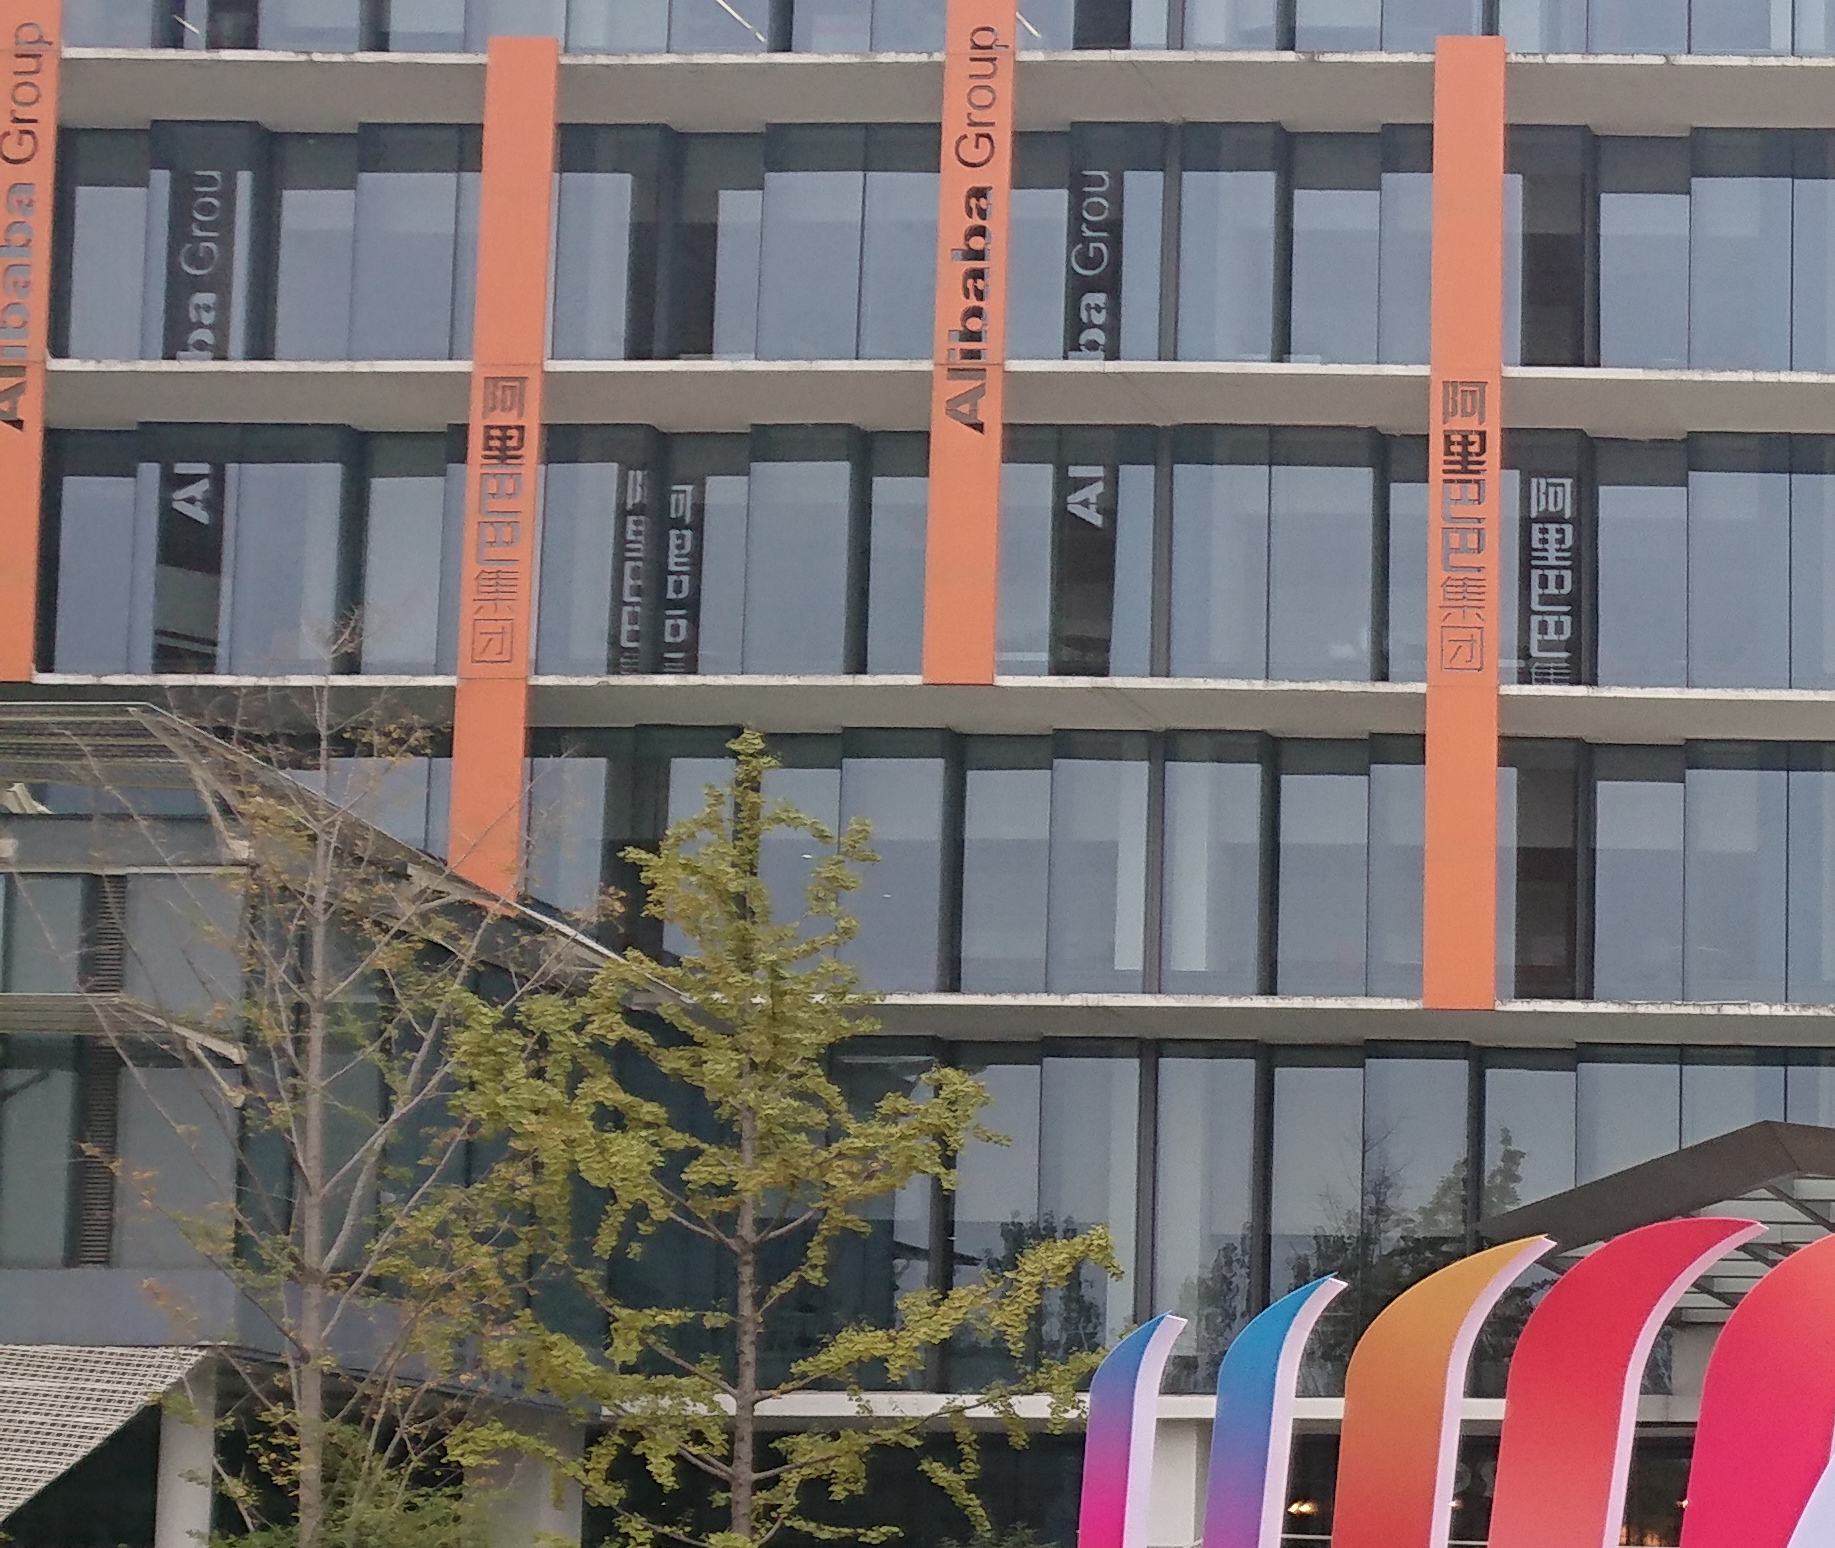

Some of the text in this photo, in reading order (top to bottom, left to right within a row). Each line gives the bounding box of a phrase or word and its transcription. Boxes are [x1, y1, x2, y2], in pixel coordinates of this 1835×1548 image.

[0, 20, 53, 166] Group
[945, 25, 1009, 436] Alibaba Group
[470, 376, 530, 664] 阿里巴巴集团
[1439, 380, 1489, 672] 阿里巴巴集团
